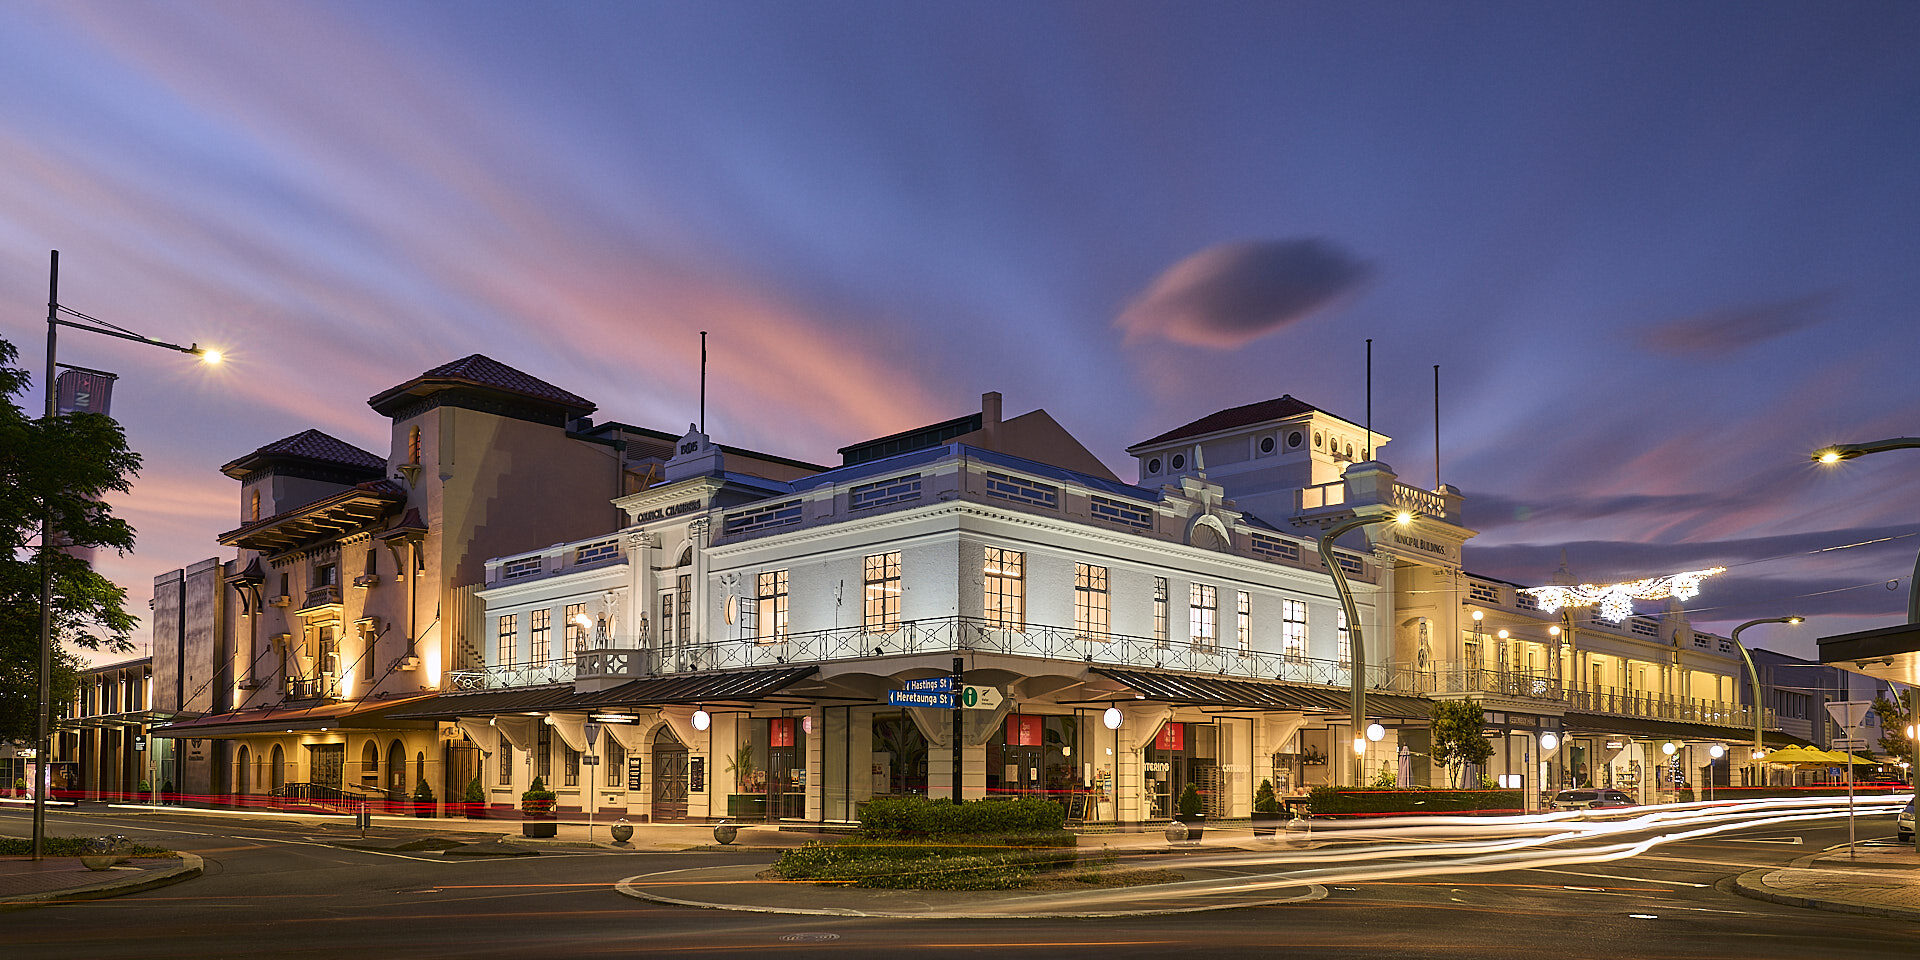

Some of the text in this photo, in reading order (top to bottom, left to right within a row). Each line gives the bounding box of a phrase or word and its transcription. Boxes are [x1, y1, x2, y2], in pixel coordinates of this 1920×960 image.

[911, 678, 947, 691] Hastings St
[896, 691, 948, 706] Heretaunga St
[1144, 762, 1170, 772] TERING
